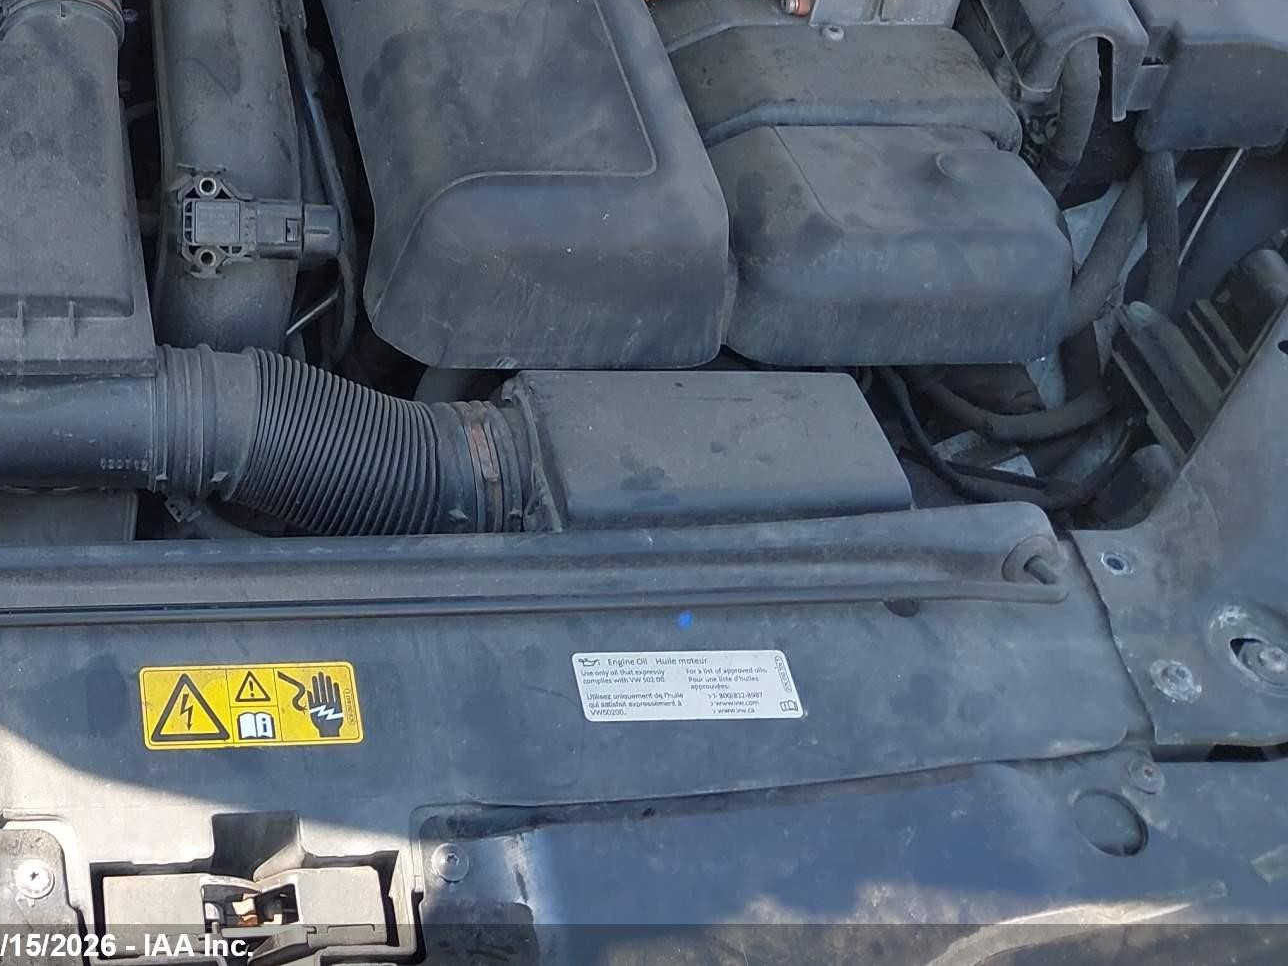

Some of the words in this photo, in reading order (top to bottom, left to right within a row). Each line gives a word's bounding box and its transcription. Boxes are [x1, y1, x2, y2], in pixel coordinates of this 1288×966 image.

[608, 658, 634, 667] Engine
[637, 658, 648, 666] Oil
[656, 657, 676, 665] Huile
[678, 657, 708, 665] moteur
